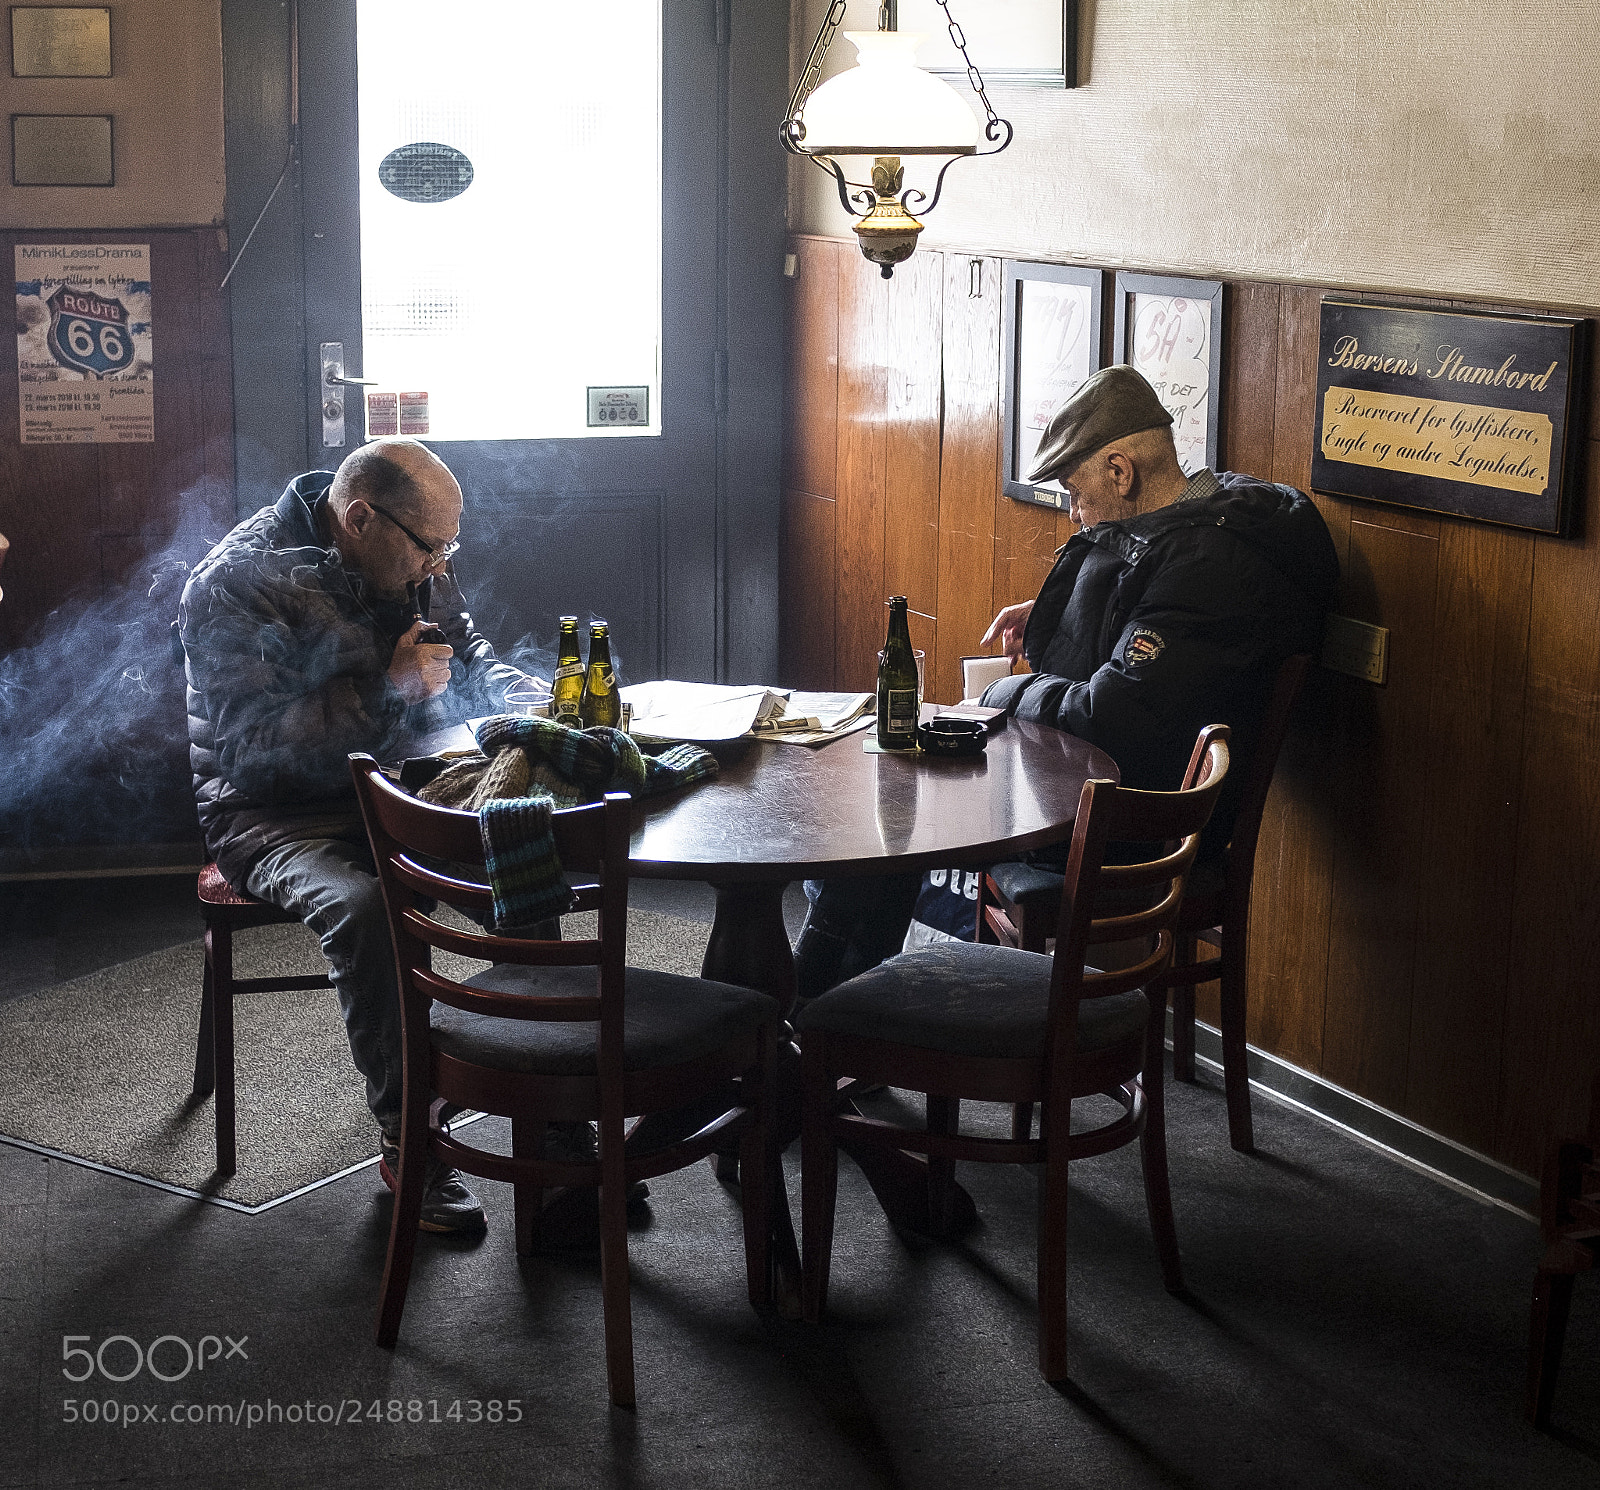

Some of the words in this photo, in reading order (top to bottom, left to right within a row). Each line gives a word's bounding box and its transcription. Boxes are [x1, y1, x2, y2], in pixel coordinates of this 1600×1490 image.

[63, 294, 120, 320] ROUTE
[68, 319, 124, 361] 66
[1170, 382, 1198, 396] DET
[1427, 344, 1558, 392] Stambord
[1334, 392, 1421, 425] Reserveret
[1416, 404, 1447, 434] for
[1450, 409, 1539, 446] lystfiskere,
[1324, 422, 1371, 456] Engle
[1372, 442, 1391, 462] og
[1396, 440, 1444, 464] andre
